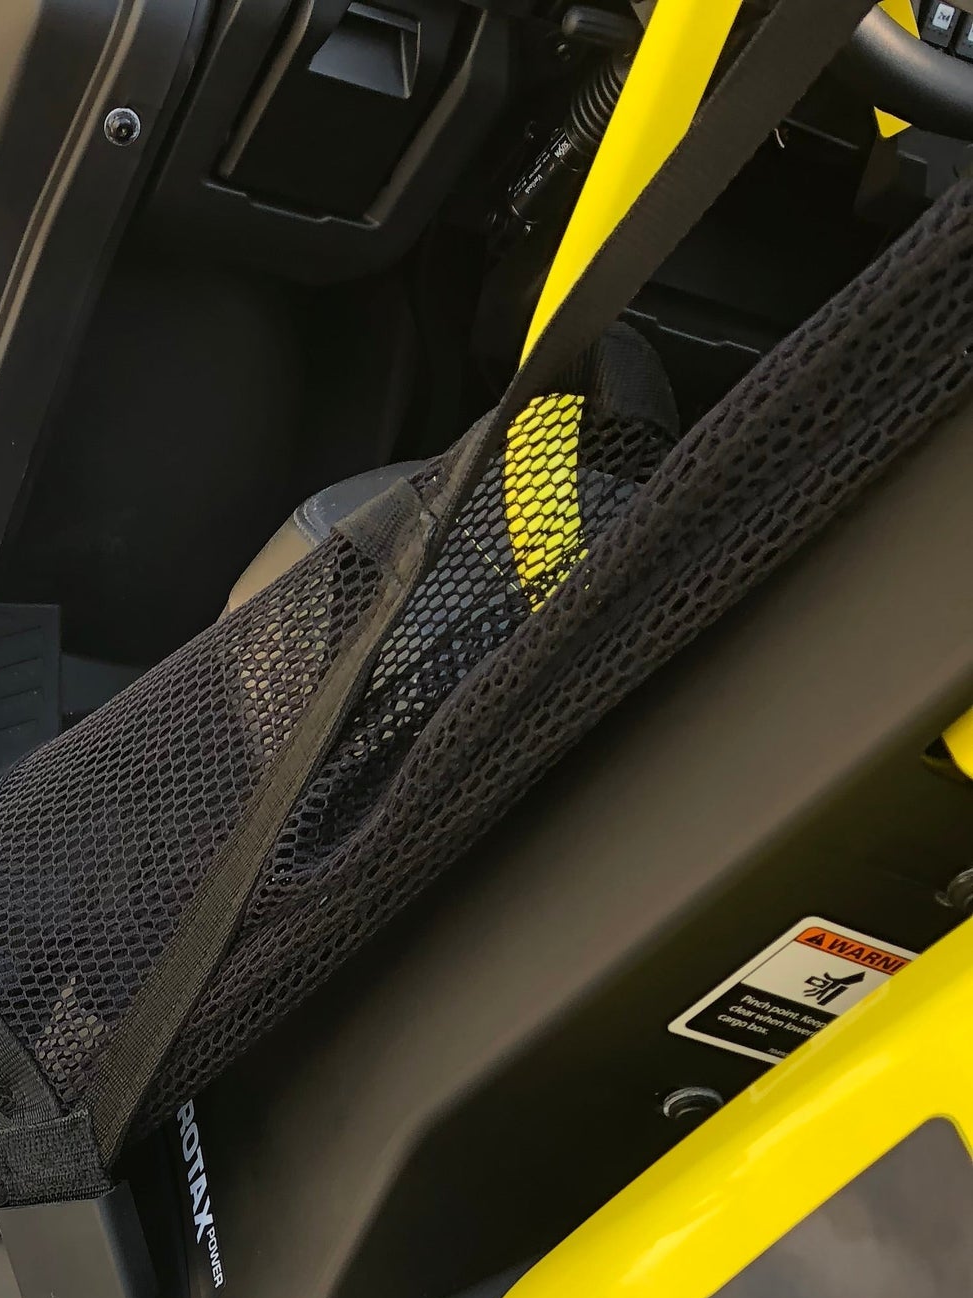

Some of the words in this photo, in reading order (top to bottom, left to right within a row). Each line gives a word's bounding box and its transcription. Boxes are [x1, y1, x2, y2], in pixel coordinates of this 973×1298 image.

[827, 938, 905, 972] WARNI
[717, 1014, 748, 1027] cargo
[747, 1022, 769, 1035] box.
[729, 1005, 756, 1017] clear
[755, 1013, 784, 1027] when
[784, 1022, 817, 1037] loweri
[741, 994, 771, 1009] Pinch
[768, 1006, 800, 1020] point.
[800, 1015, 827, 1029] Keep
[177, 1099, 214, 1244] ROTAX
[206, 1226, 225, 1289] POWER
